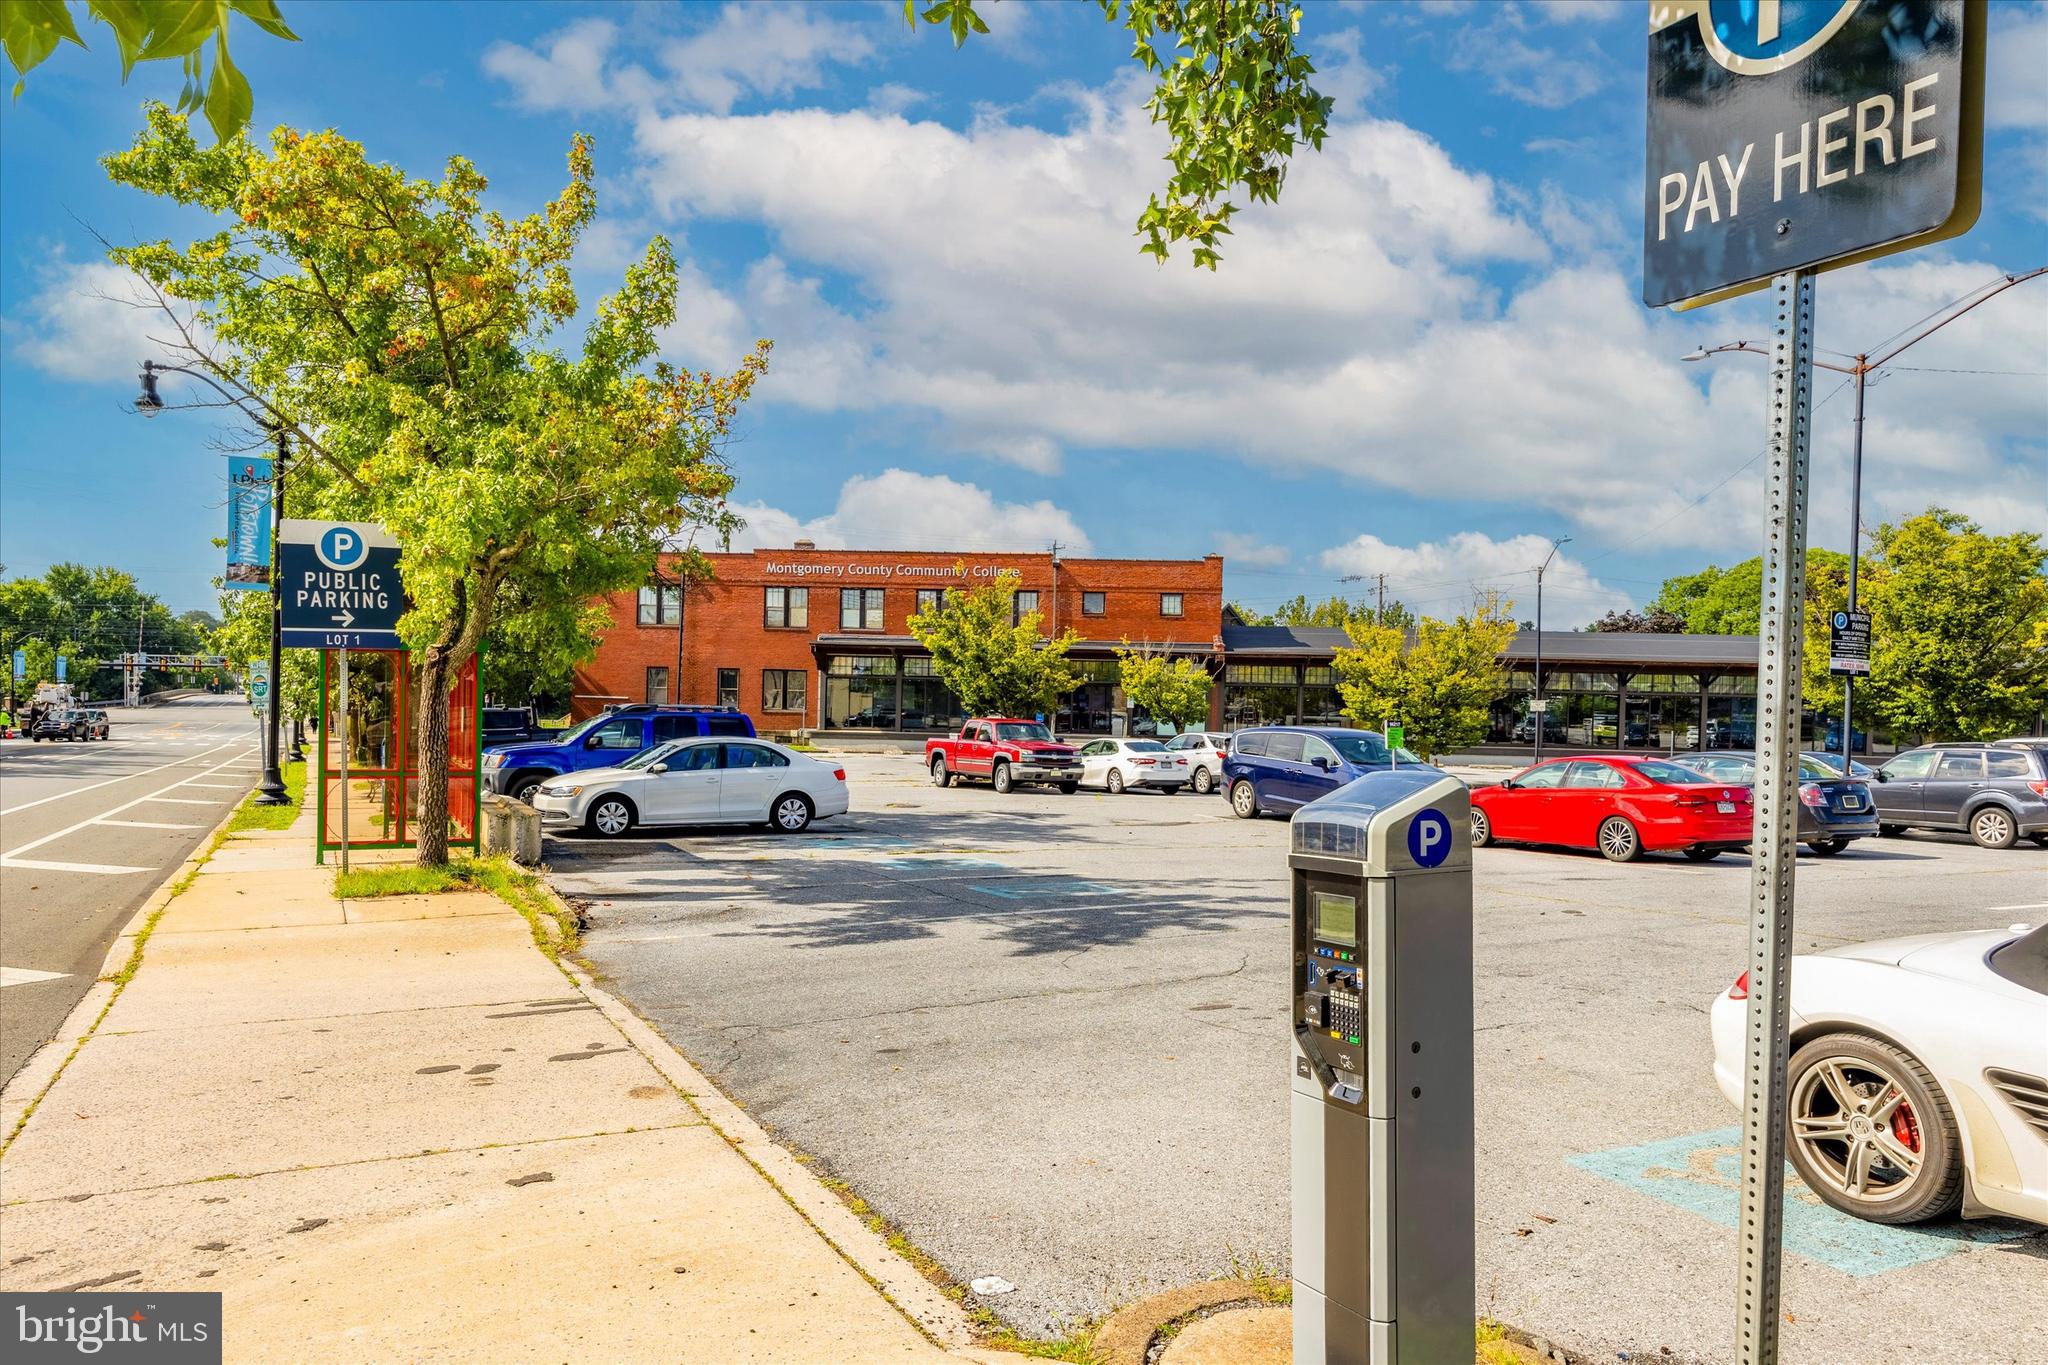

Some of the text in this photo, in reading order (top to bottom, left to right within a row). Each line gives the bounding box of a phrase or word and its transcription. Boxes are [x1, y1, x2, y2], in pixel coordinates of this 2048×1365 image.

[1657, 72, 1939, 242] PAY HERE
[334, 533, 353, 560] P
[766, 562, 844, 577] Montgomery
[848, 563, 892, 578] County
[304, 571, 380, 591] PUBLIC
[297, 590, 388, 609] PARKING
[326, 634, 360, 645] LOT 1
[253, 685, 267, 693] SRT
[1420, 820, 1442, 857] P
